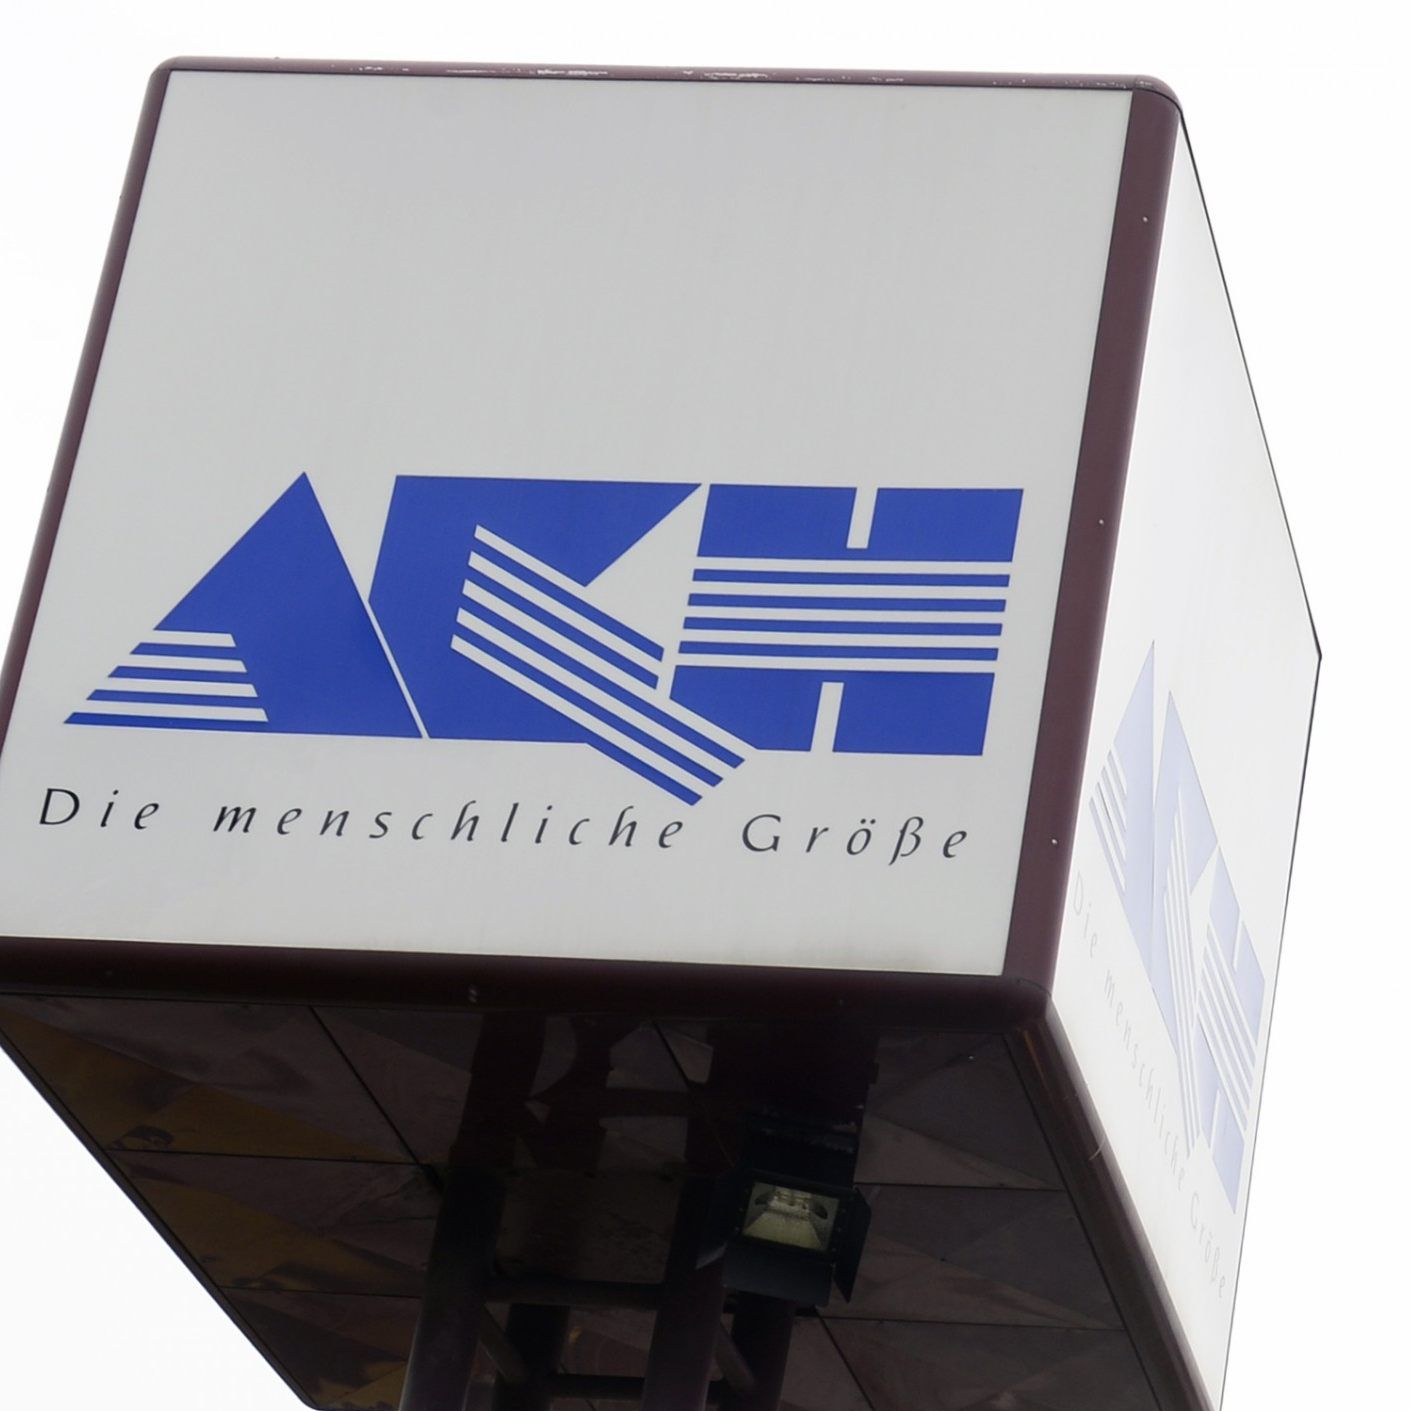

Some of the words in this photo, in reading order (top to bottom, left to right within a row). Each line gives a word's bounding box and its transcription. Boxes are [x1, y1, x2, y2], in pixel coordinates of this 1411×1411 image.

[65, 472, 1024, 805] AKH
[38, 786, 161, 831] Die
[212, 801, 686, 851] menschliche
[741, 812, 969, 866] Größe
[1072, 869, 1098, 960] Die
[1104, 968, 1185, 1193] menschliche
